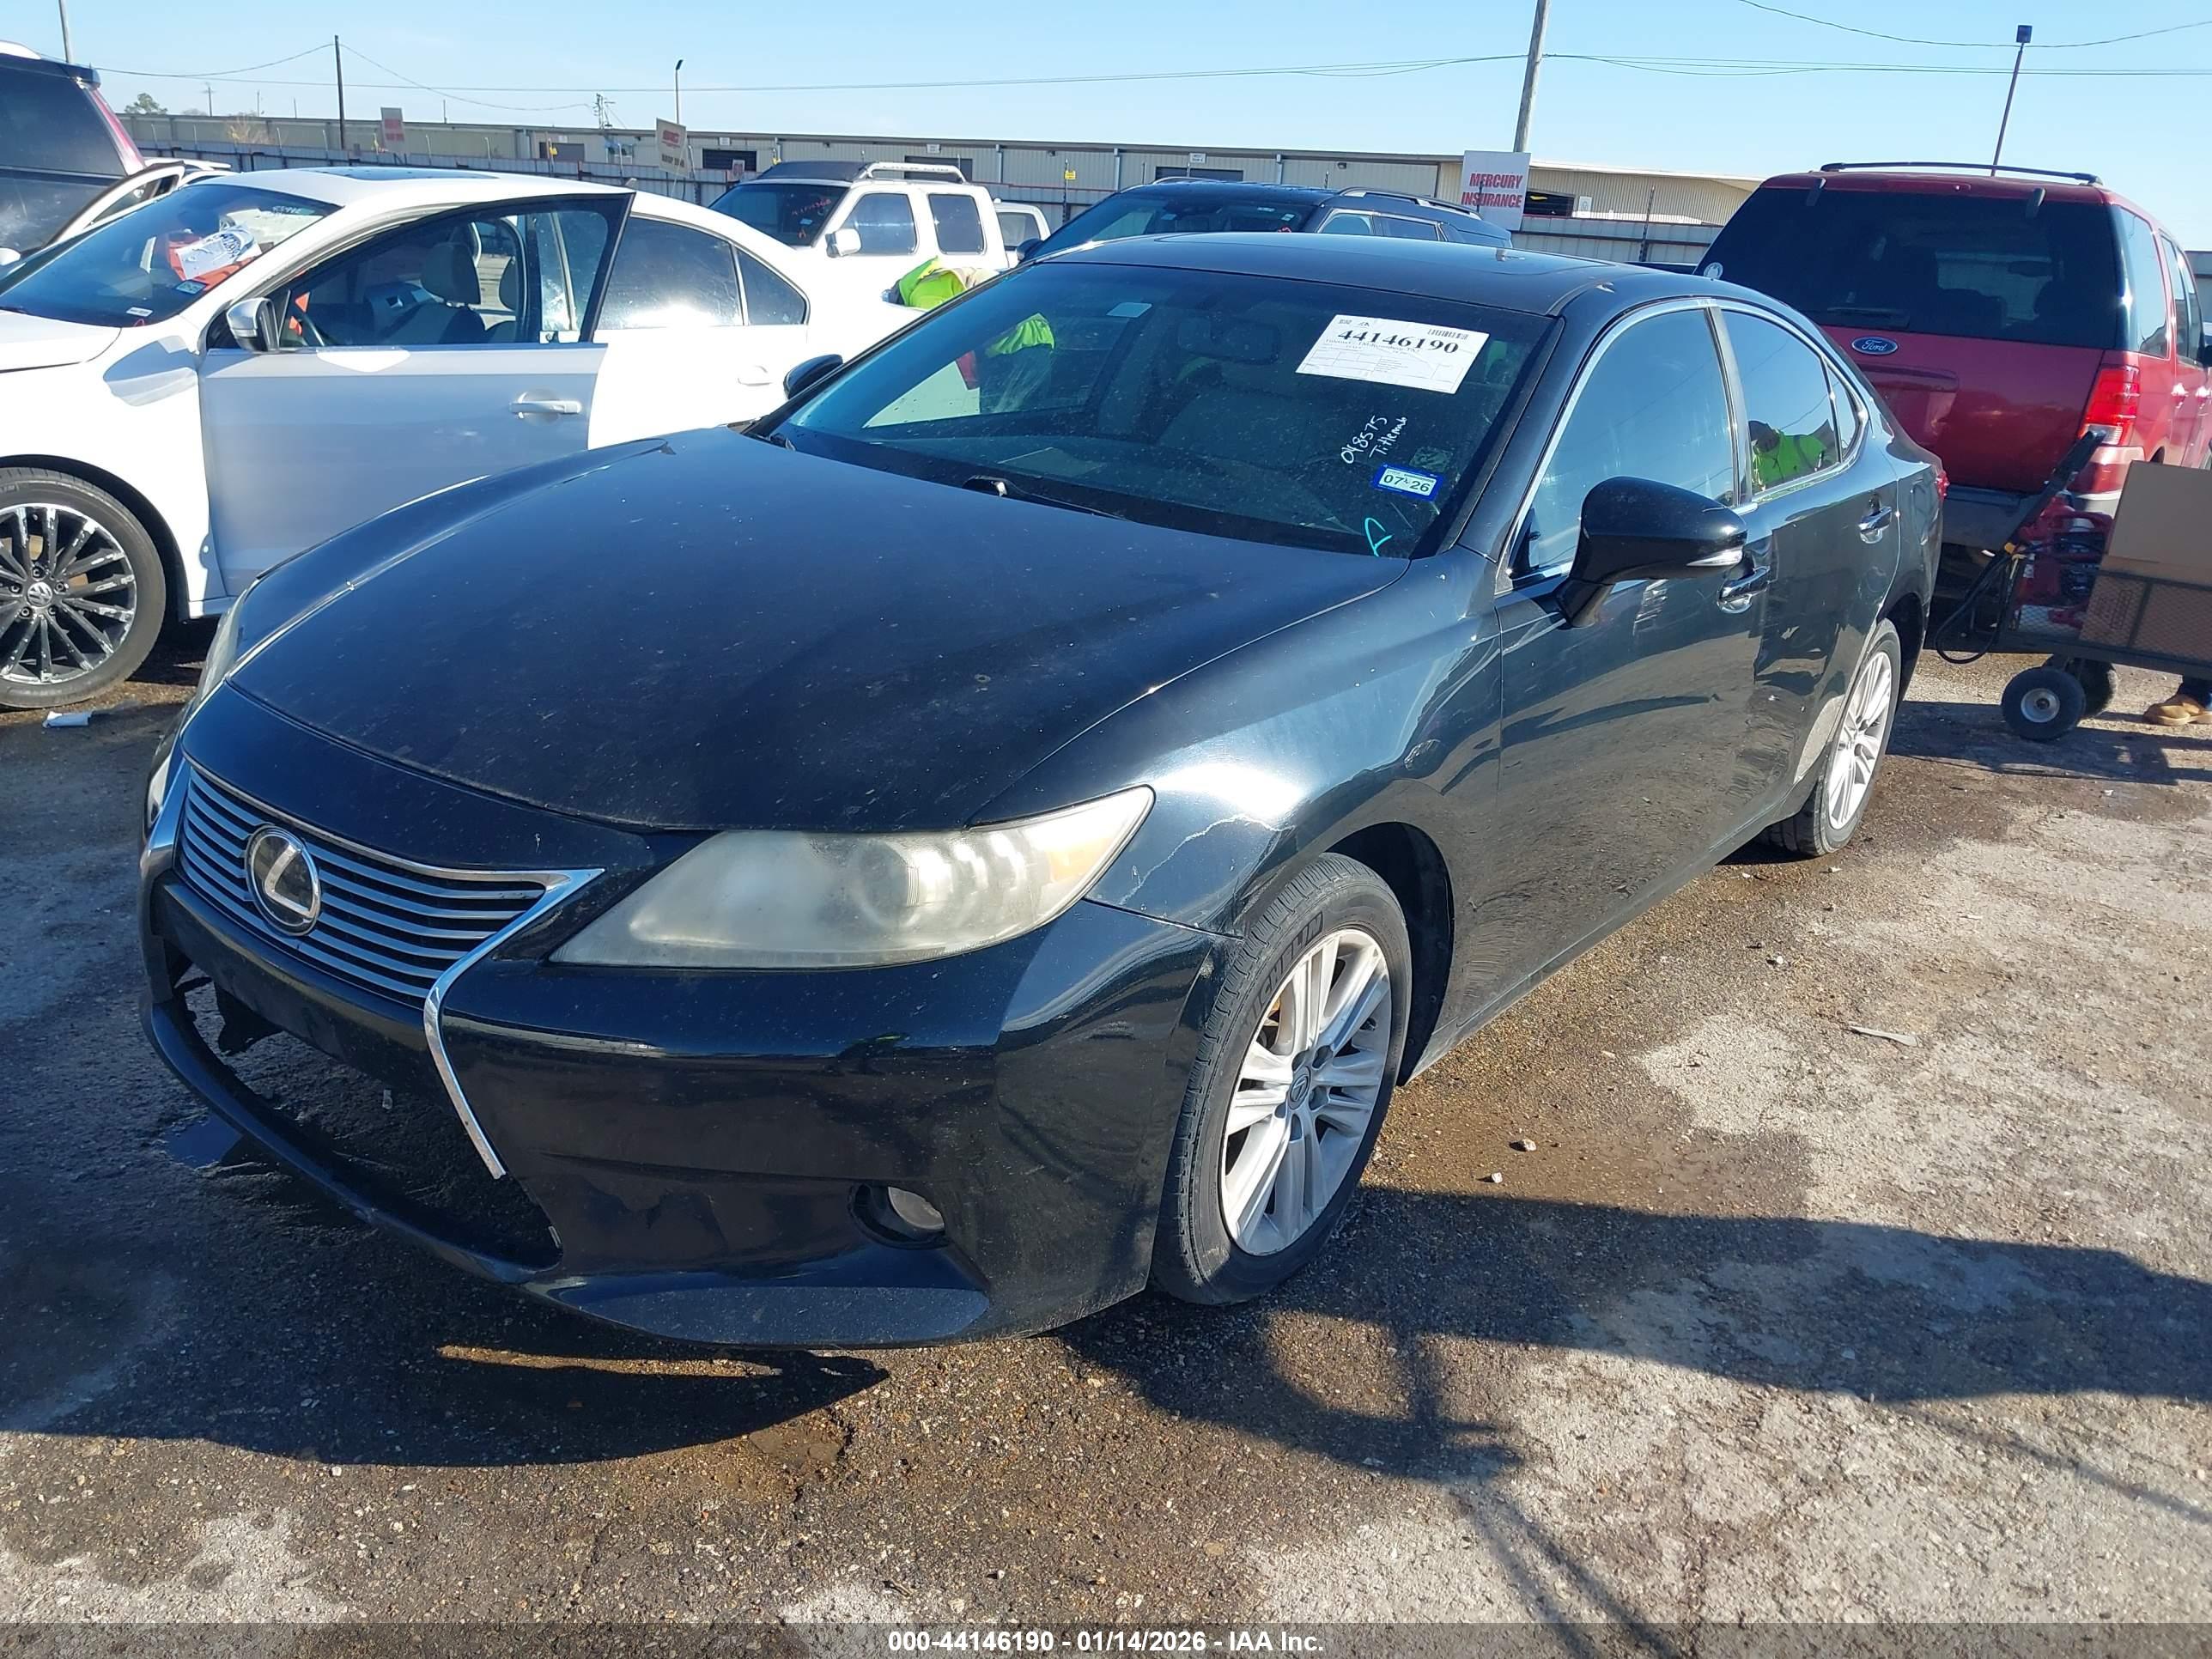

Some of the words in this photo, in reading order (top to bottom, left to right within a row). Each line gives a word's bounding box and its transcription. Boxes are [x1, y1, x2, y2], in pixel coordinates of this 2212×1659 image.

[1469, 173, 1523, 189] MERCURY
[1461, 191, 1522, 208] INSURANCE
[1338, 330, 1459, 354] 44146190
[1861, 339, 1888, 351] Ford
[1341, 415, 1388, 464] 048575
